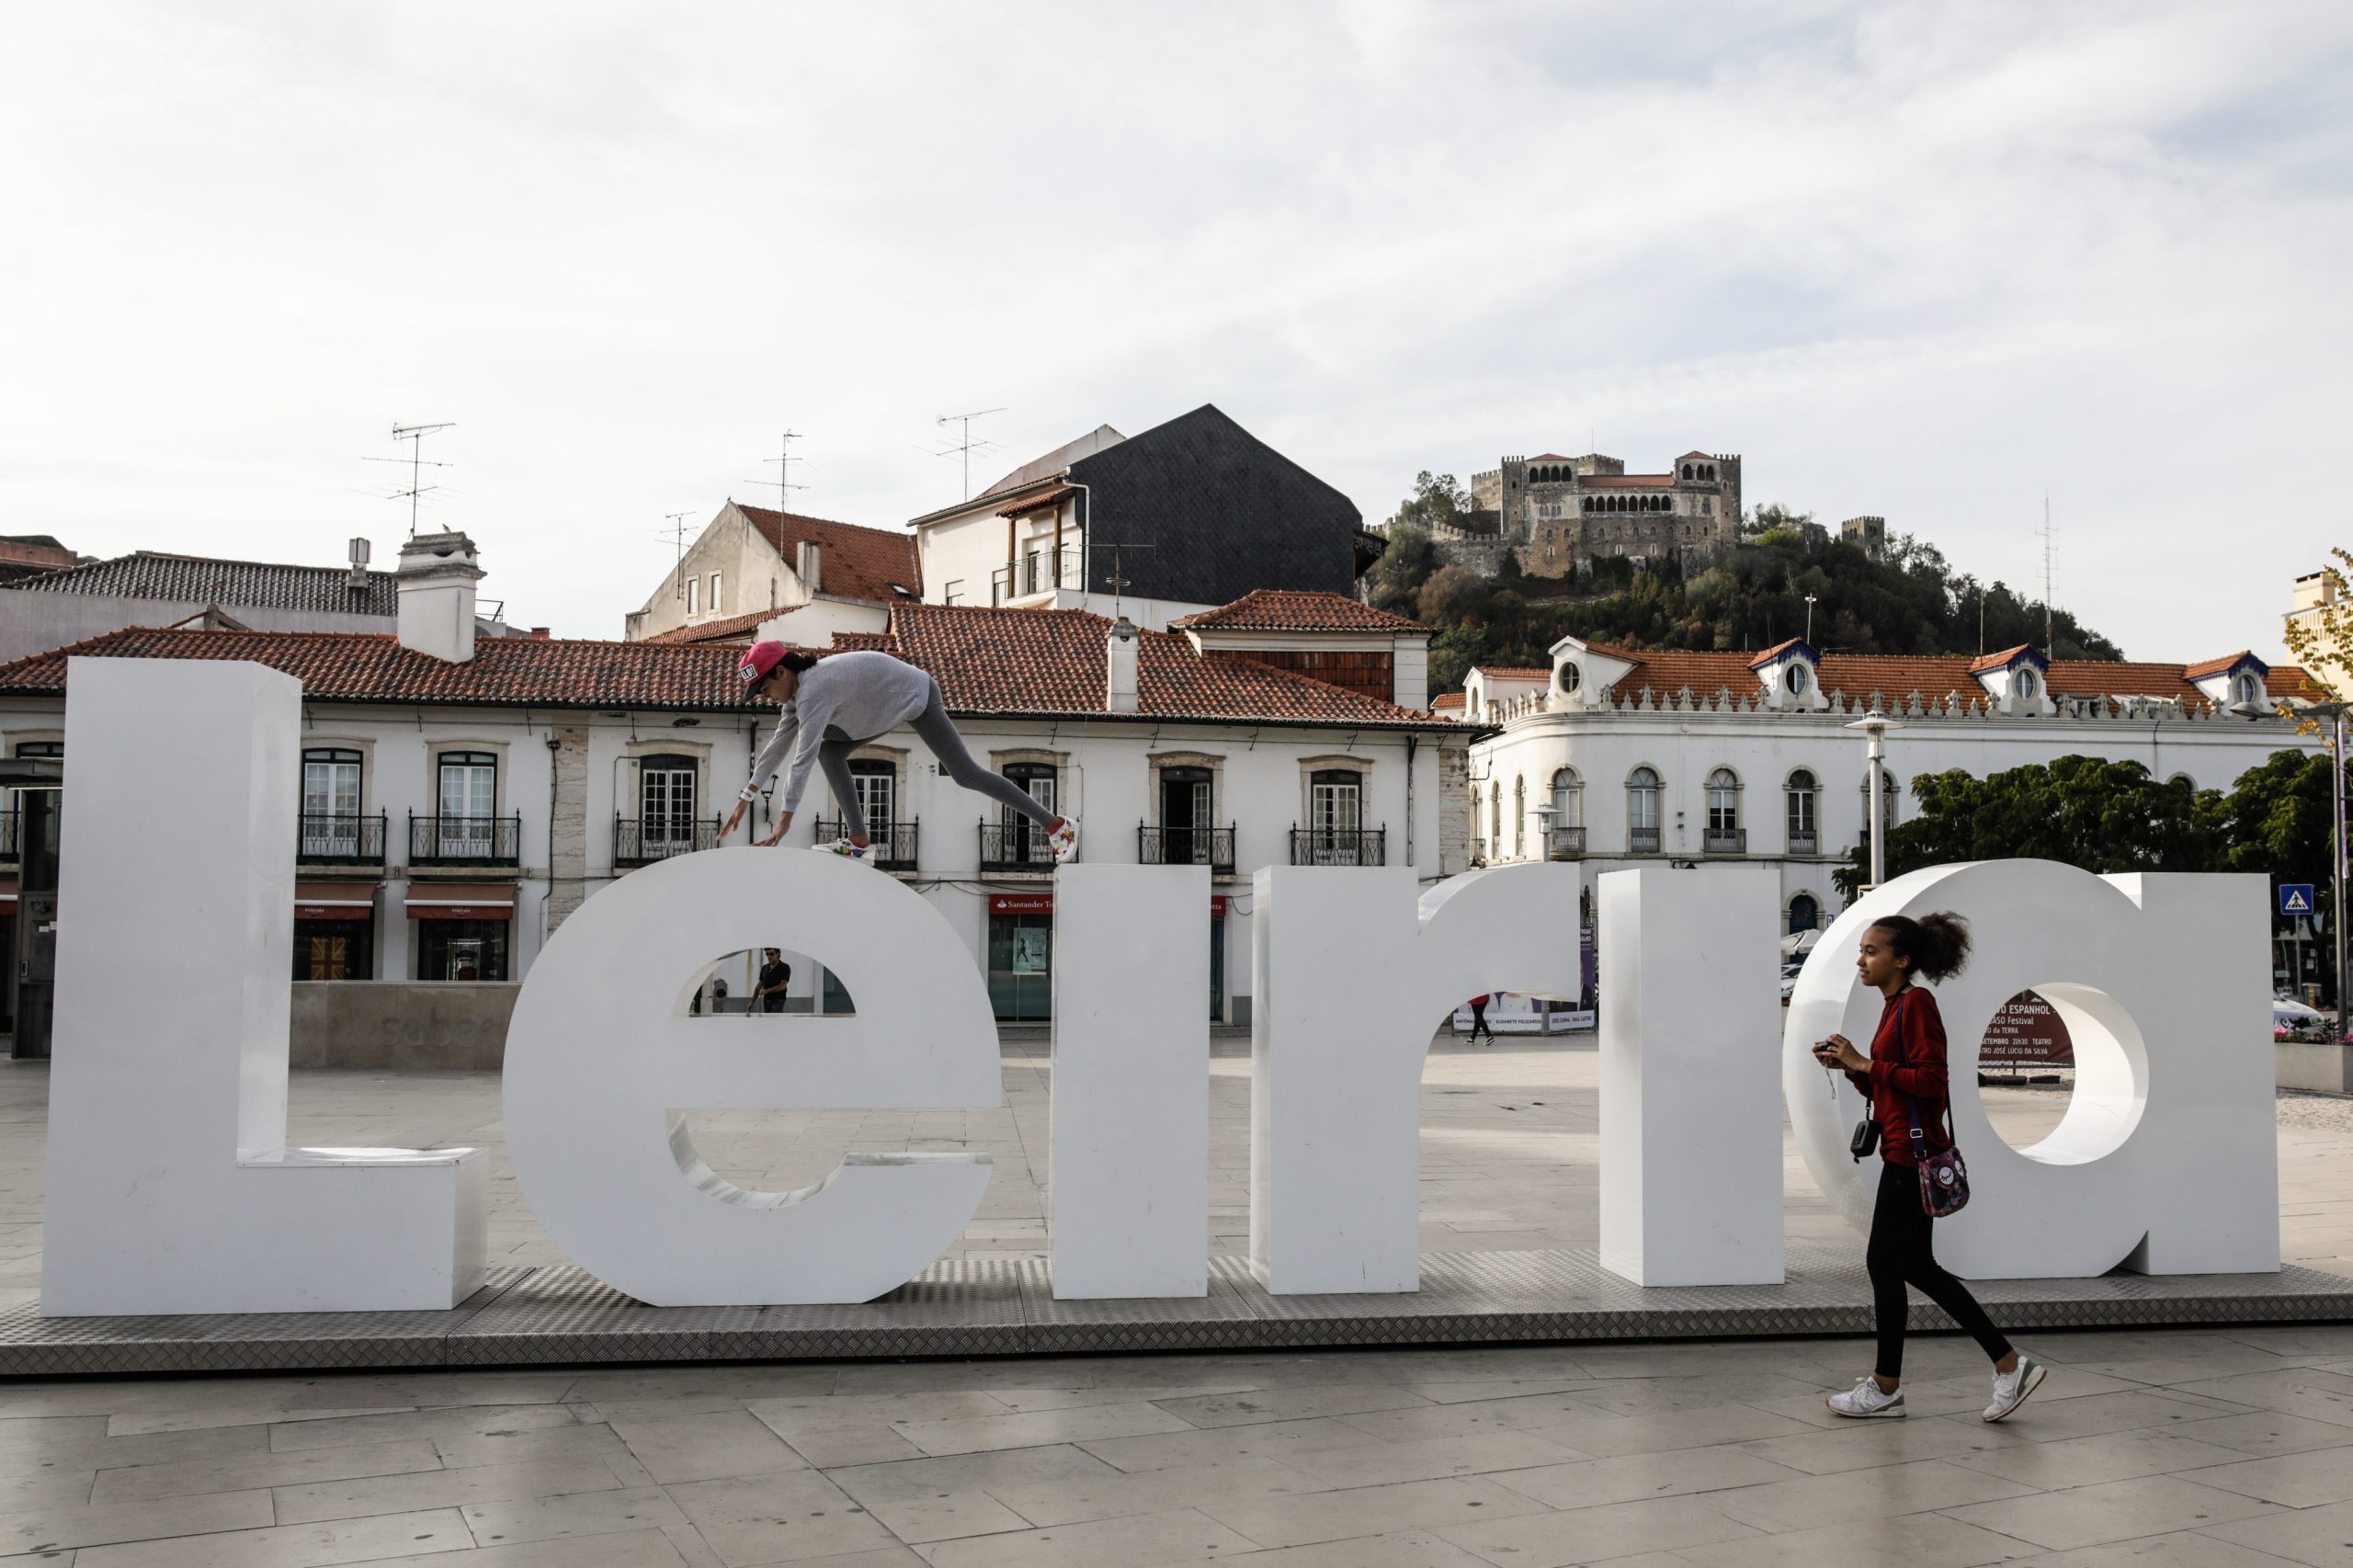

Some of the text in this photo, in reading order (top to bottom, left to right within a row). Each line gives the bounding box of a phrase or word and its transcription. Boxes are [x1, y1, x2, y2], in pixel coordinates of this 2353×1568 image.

[41, 656, 2280, 1318] Leiria
[2009, 1005, 2051, 1015] ESPANHOL
[2007, 1016, 2034, 1025] Festival
[381, 1007, 477, 1046] saba
[1993, 1046, 2006, 1054] JOSÉ
